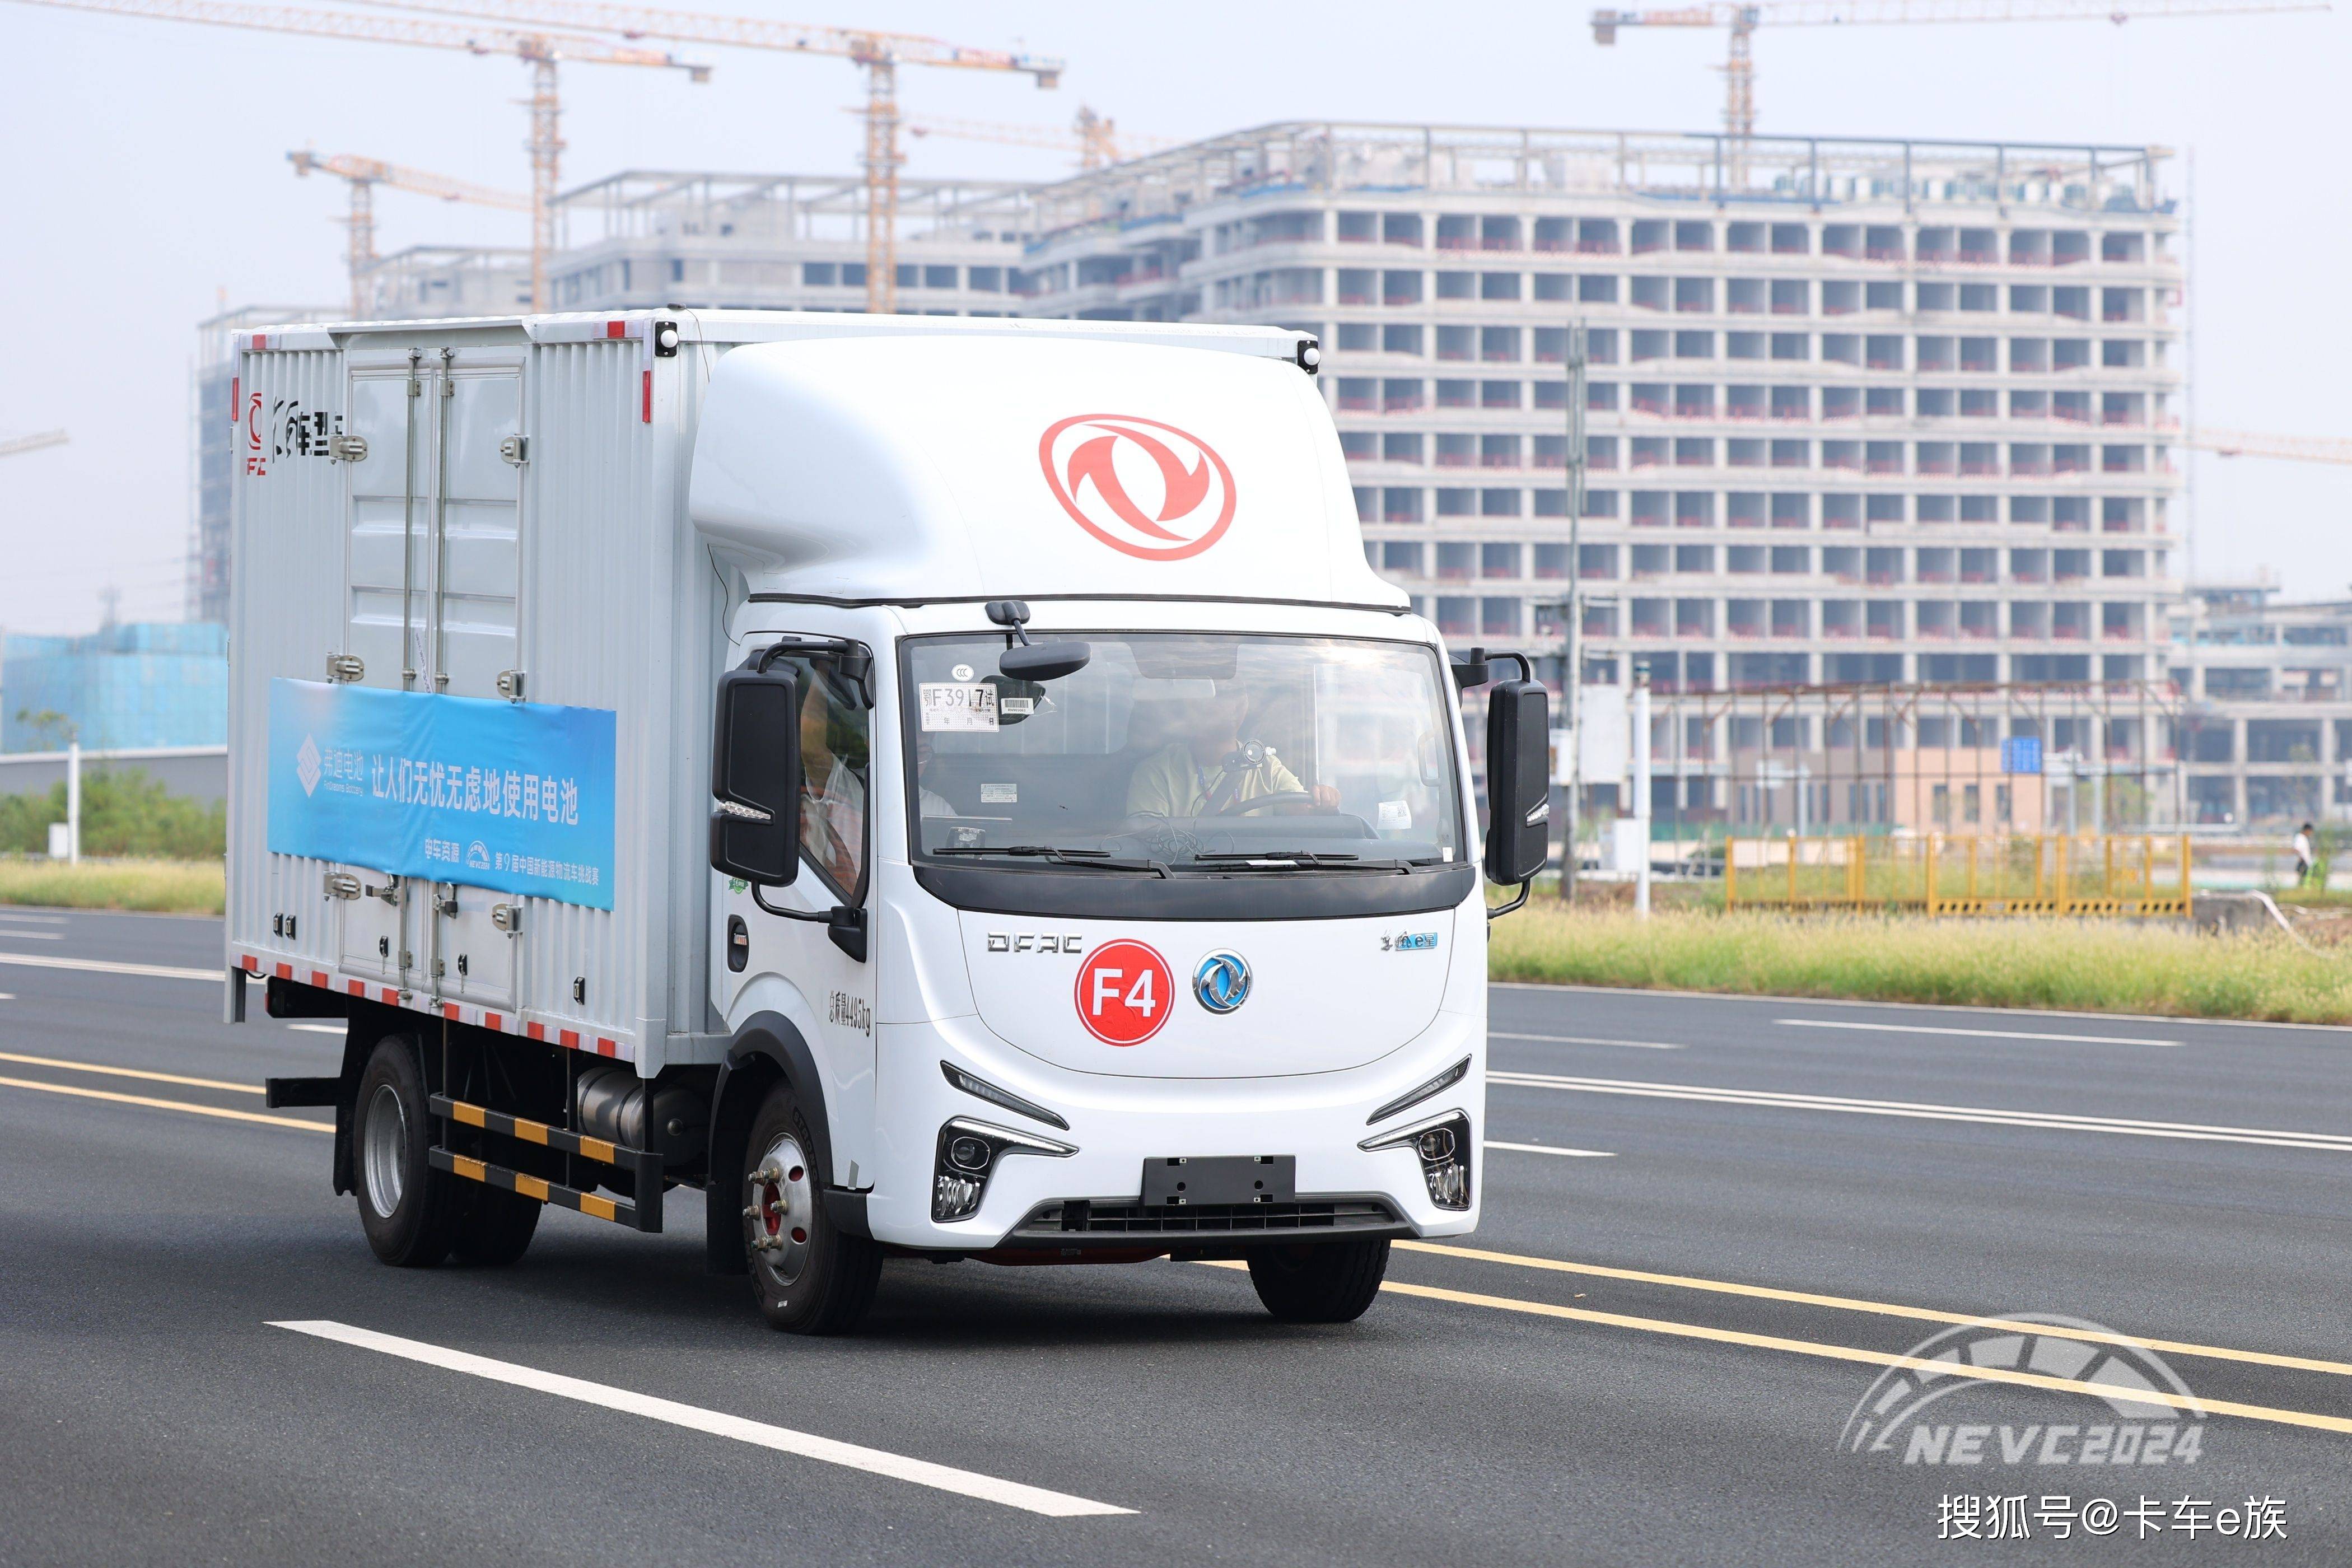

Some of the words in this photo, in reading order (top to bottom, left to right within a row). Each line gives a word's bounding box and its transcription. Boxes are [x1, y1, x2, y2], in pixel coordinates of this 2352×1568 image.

[923, 689, 994, 707] 鄂F3917试
[324, 746, 363, 781] 弗迪电池
[371, 754, 579, 825] 让人们无忧无虑地使用电池
[987, 931, 1083, 953] DFAC
[1093, 967, 1156, 1018] F4
